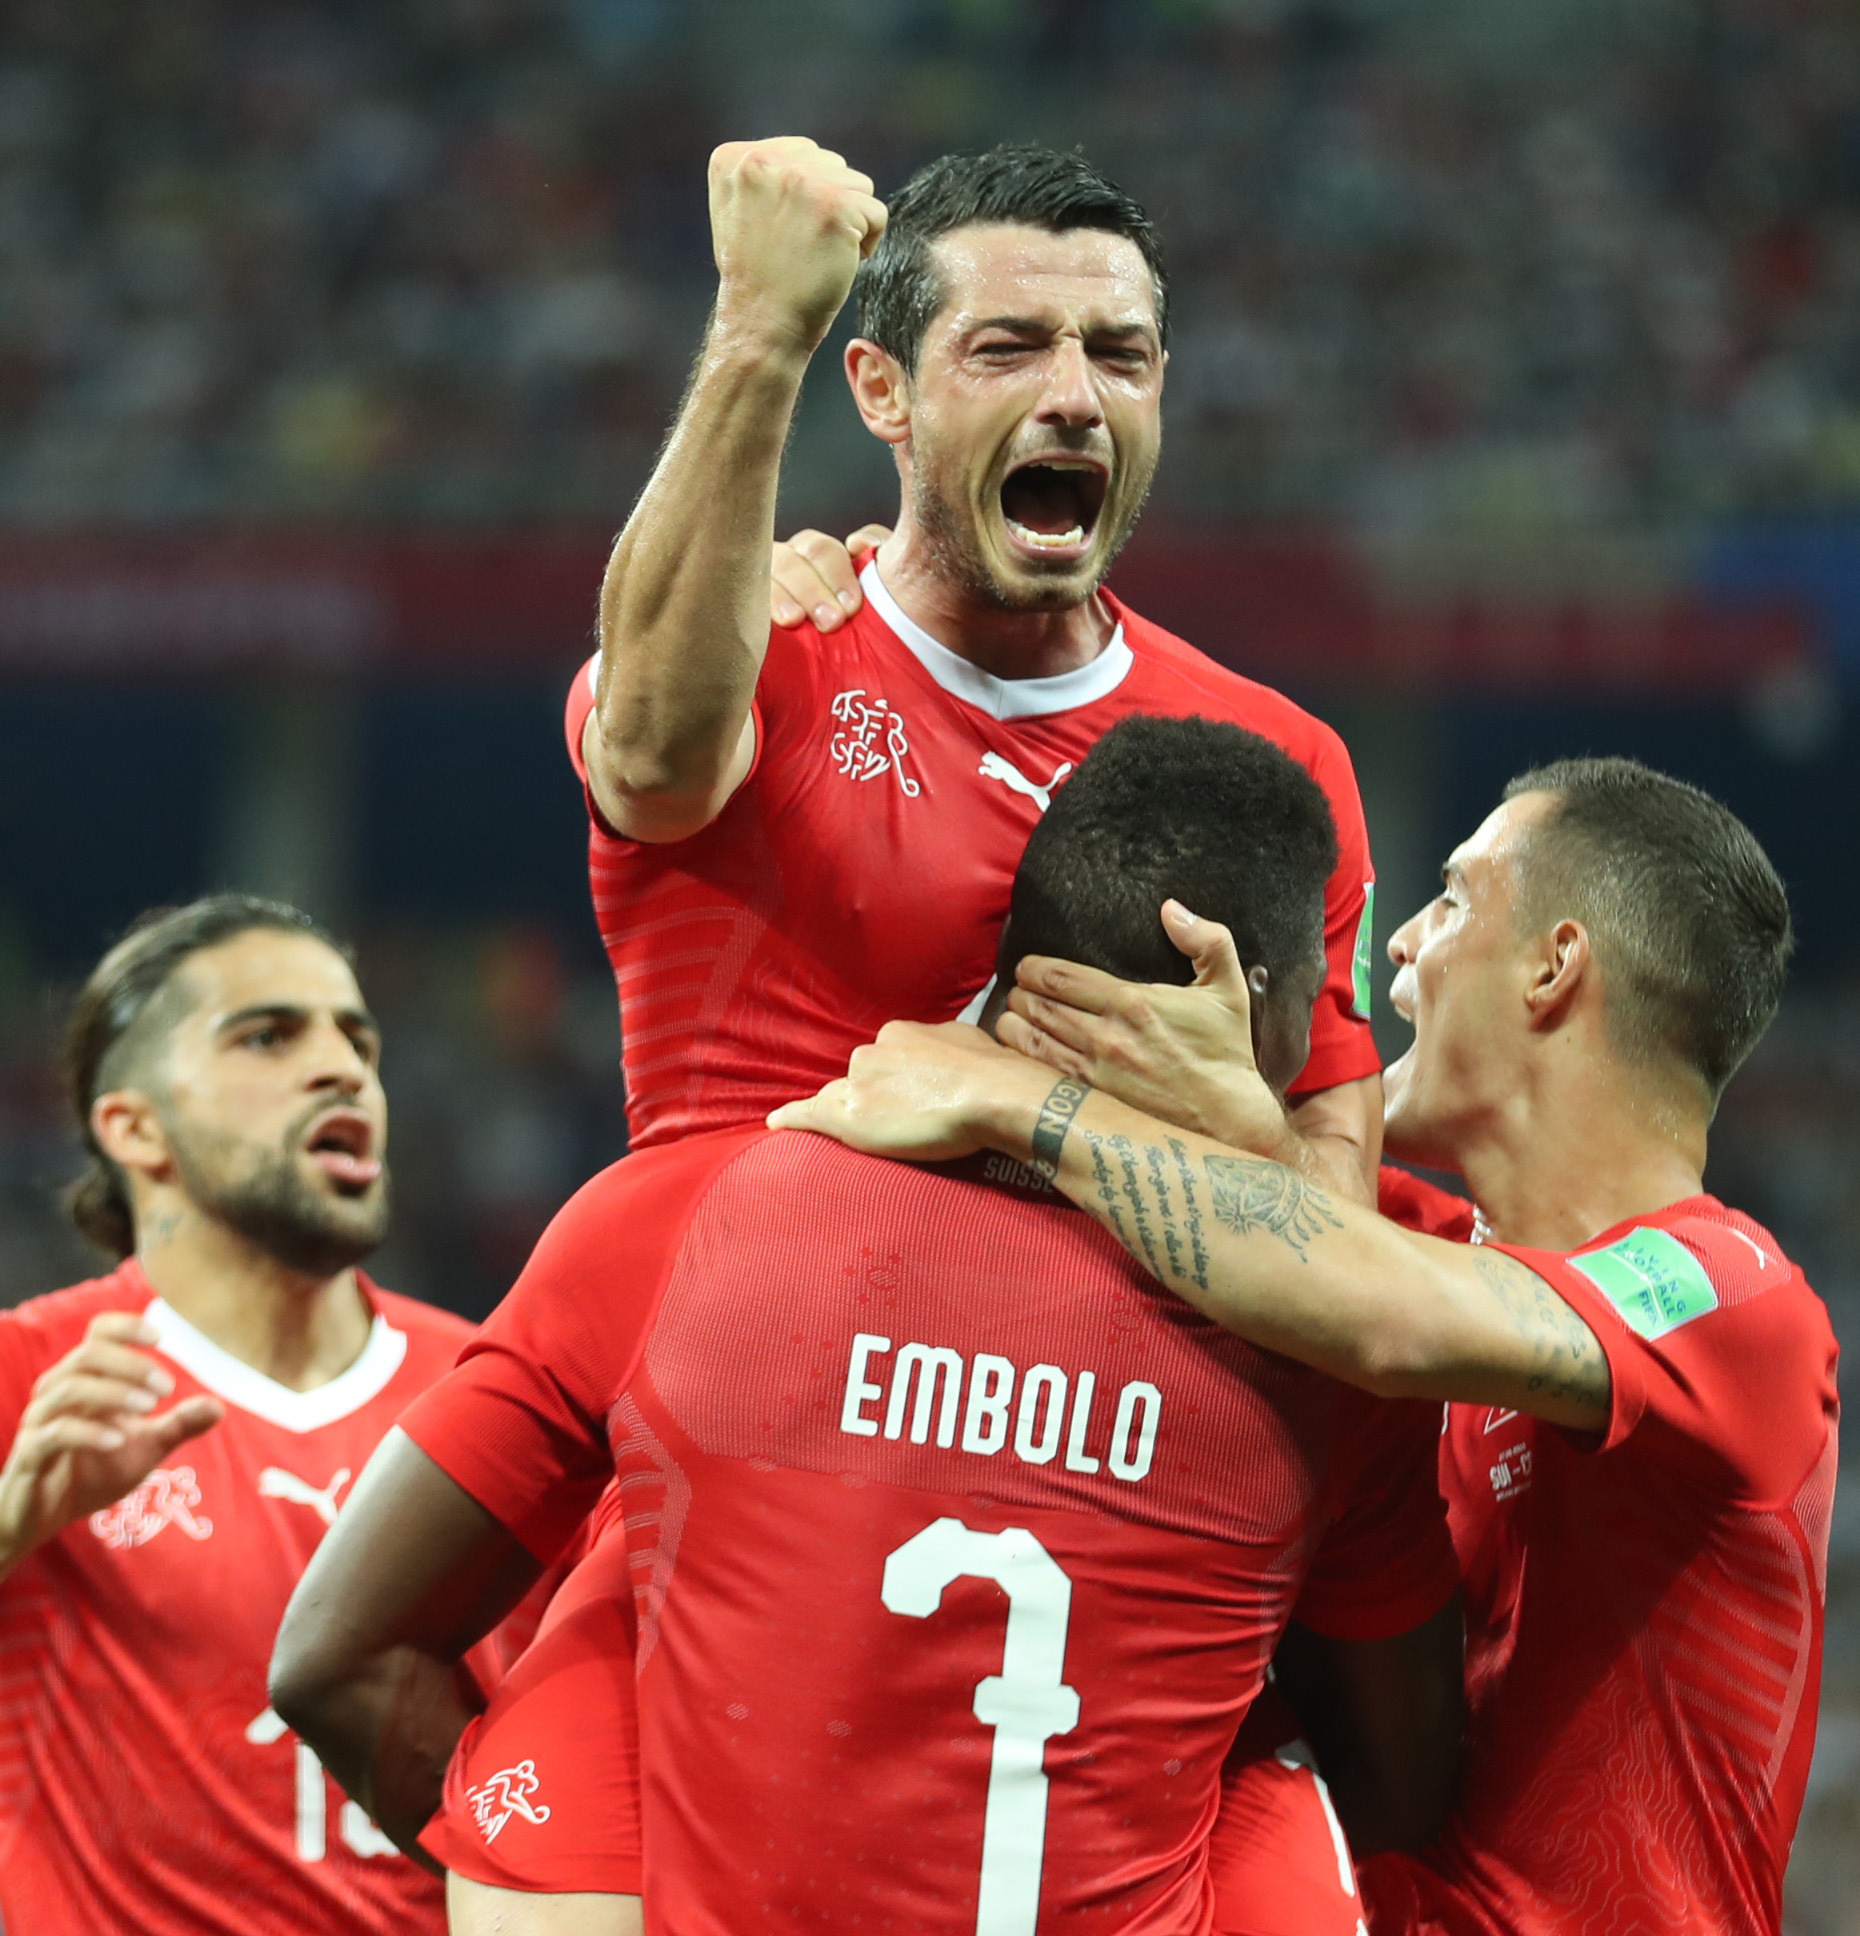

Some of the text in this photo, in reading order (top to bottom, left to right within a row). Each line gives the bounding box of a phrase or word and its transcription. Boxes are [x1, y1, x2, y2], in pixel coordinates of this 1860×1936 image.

[1038, 1080, 1084, 1136] GON
[839, 1332, 1163, 1483] EMBOLO
[1489, 1461, 1512, 1491] SUI
[880, 1516, 1081, 1936] 7
